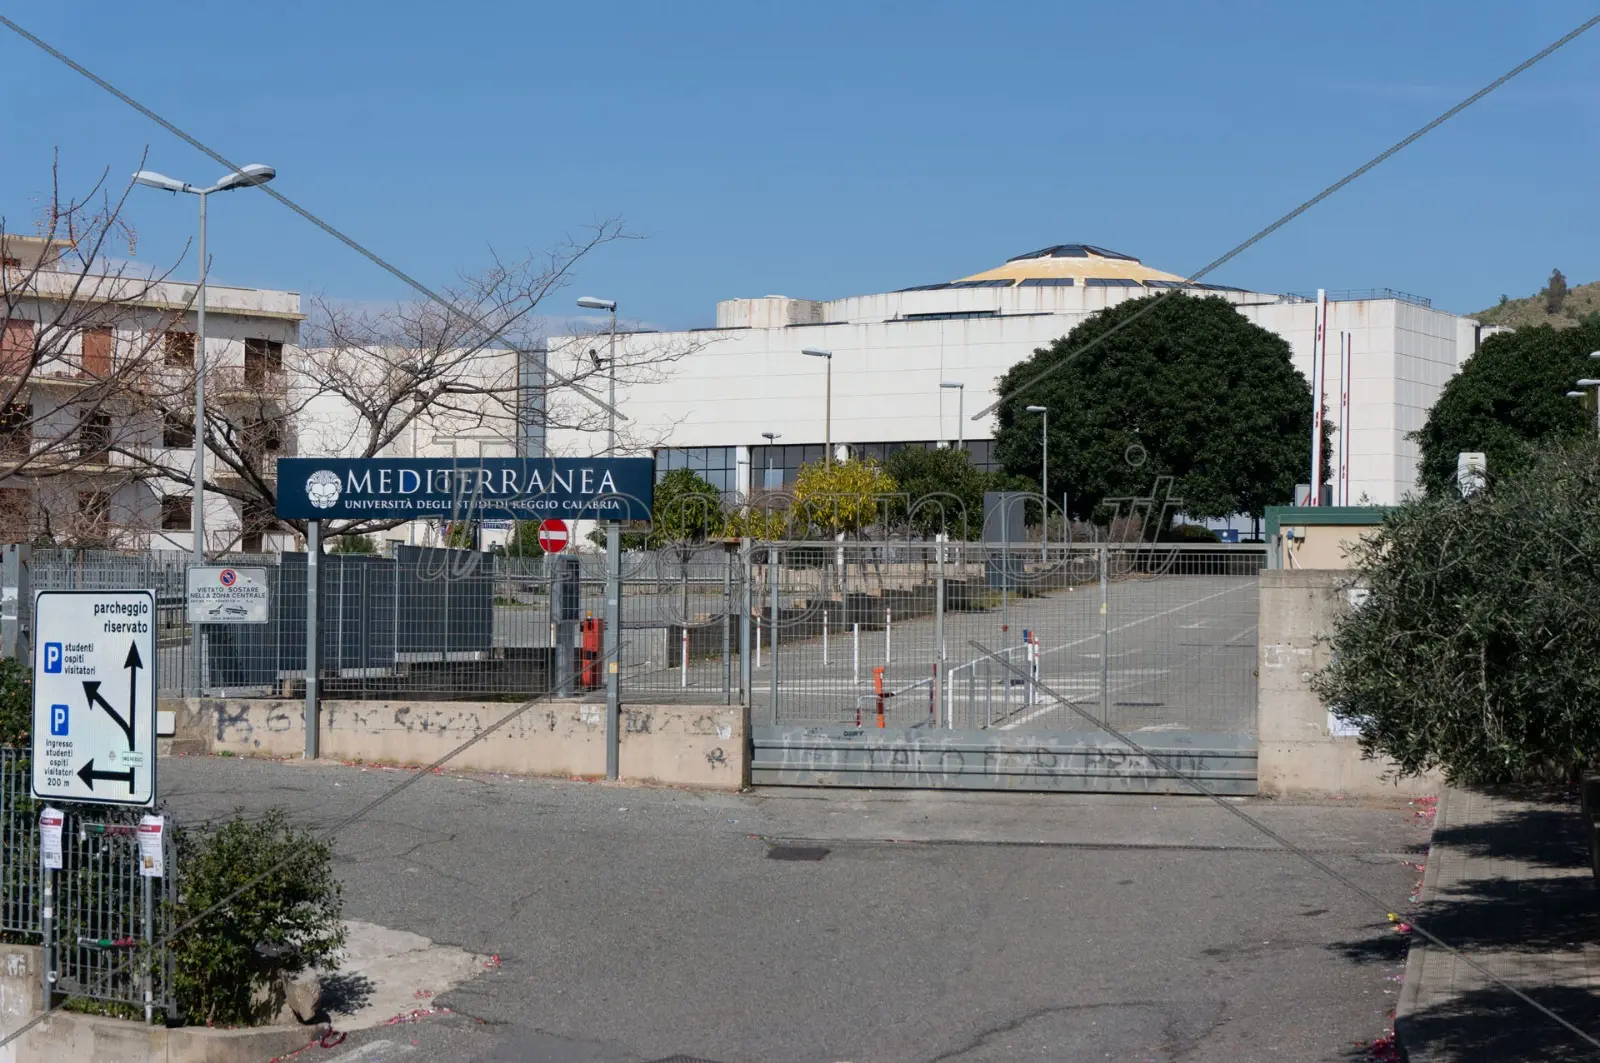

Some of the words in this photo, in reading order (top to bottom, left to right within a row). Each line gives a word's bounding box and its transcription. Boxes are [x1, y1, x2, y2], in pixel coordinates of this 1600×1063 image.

[345, 468, 618, 494] MEDITERRANEA
[344, 498, 414, 509] UNIVERSITÀ
[416, 500, 452, 509] DEGLI
[456, 500, 492, 509] STUDI
[495, 500, 508, 509] DI
[512, 500, 559, 509] REGGIO
[562, 500, 620, 510] CALABRIA
[94, 601, 148, 616] parcheggio
[104, 620, 148, 633] riservato
[65, 643, 94, 652] studenti
[64, 654, 84, 664] ospiti
[64, 666, 96, 675] visitatori
[45, 739, 74, 748] ingresso
[45, 749, 73, 758] studenti
[49, 759, 69, 767] ospiti
[44, 768, 74, 777] visitatori
[47, 778, 62, 787] 200
